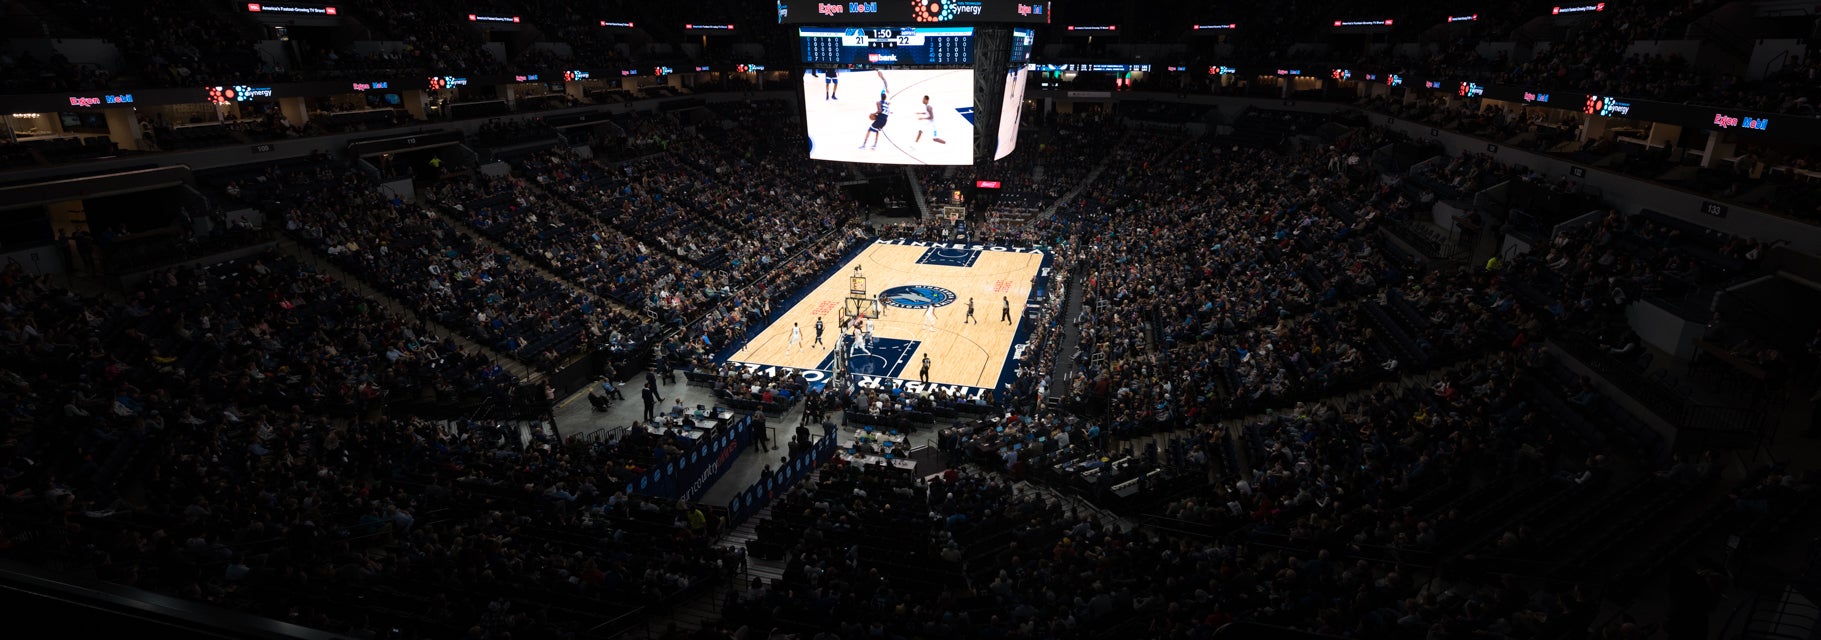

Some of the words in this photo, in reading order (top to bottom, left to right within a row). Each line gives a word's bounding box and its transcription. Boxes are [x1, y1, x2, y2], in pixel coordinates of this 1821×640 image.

[819, 3, 843, 16] Exxon
[849, 2, 877, 12] Mobil
[952, 4, 982, 15] Synergy
[873, 29, 892, 38] 1:50
[69, 97, 101, 107] Exxon
[105, 94, 134, 104] Mobil
[1714, 113, 1738, 128] Exxon
[1742, 116, 1768, 130] Mobil
[877, 237, 1043, 255] MINNESOTA
